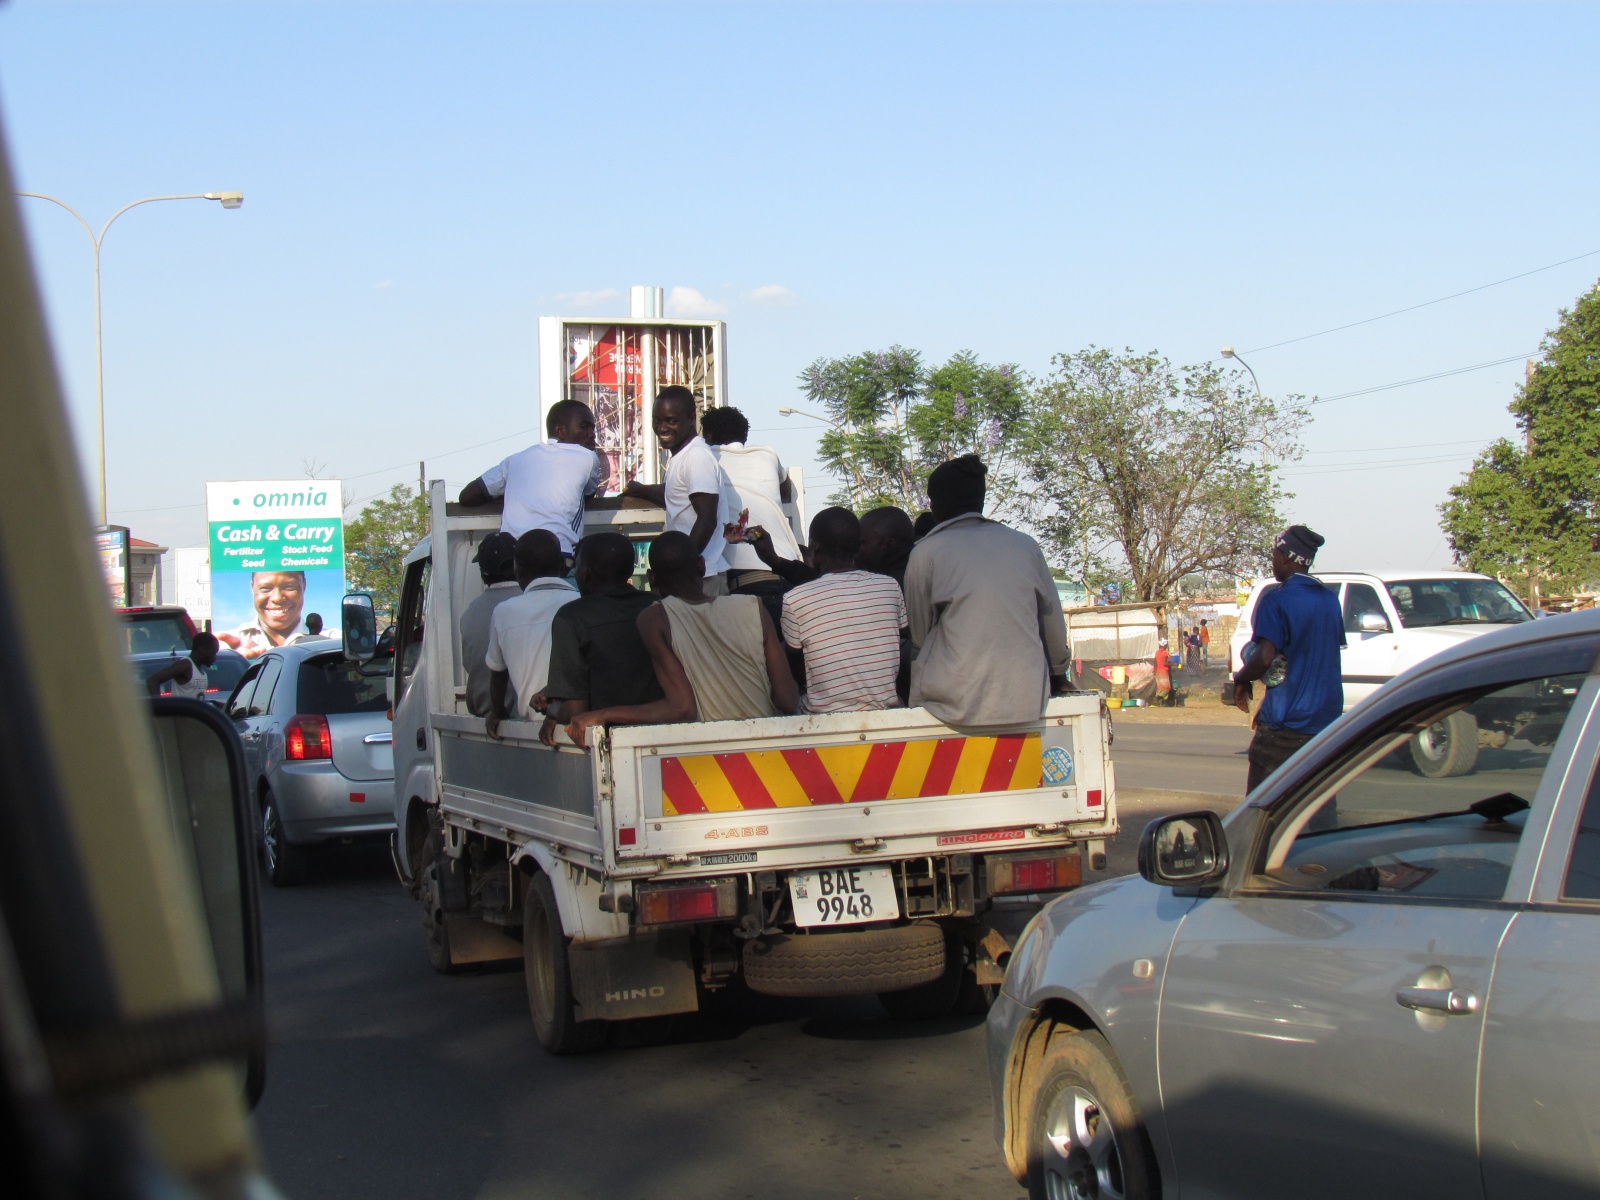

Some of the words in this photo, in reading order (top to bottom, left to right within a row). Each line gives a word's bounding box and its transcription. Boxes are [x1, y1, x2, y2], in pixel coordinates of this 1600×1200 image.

[253, 486, 327, 507] omnia
[217, 525, 261, 542] Cash
[265, 524, 280, 540] &
[284, 523, 335, 543] Carry
[223, 547, 265, 556] Fertilizer
[281, 545, 308, 554] Stock
[310, 544, 333, 553] Feed
[242, 559, 265, 568] Seed
[281, 557, 329, 567] Chemicals
[704, 825, 769, 839] 4-ABS
[937, 834, 978, 846] HINO
[979, 830, 1024, 841] DUTRO
[818, 868, 865, 896] BAE
[816, 894, 873, 922] 9948
[605, 986, 665, 1002] HINO
